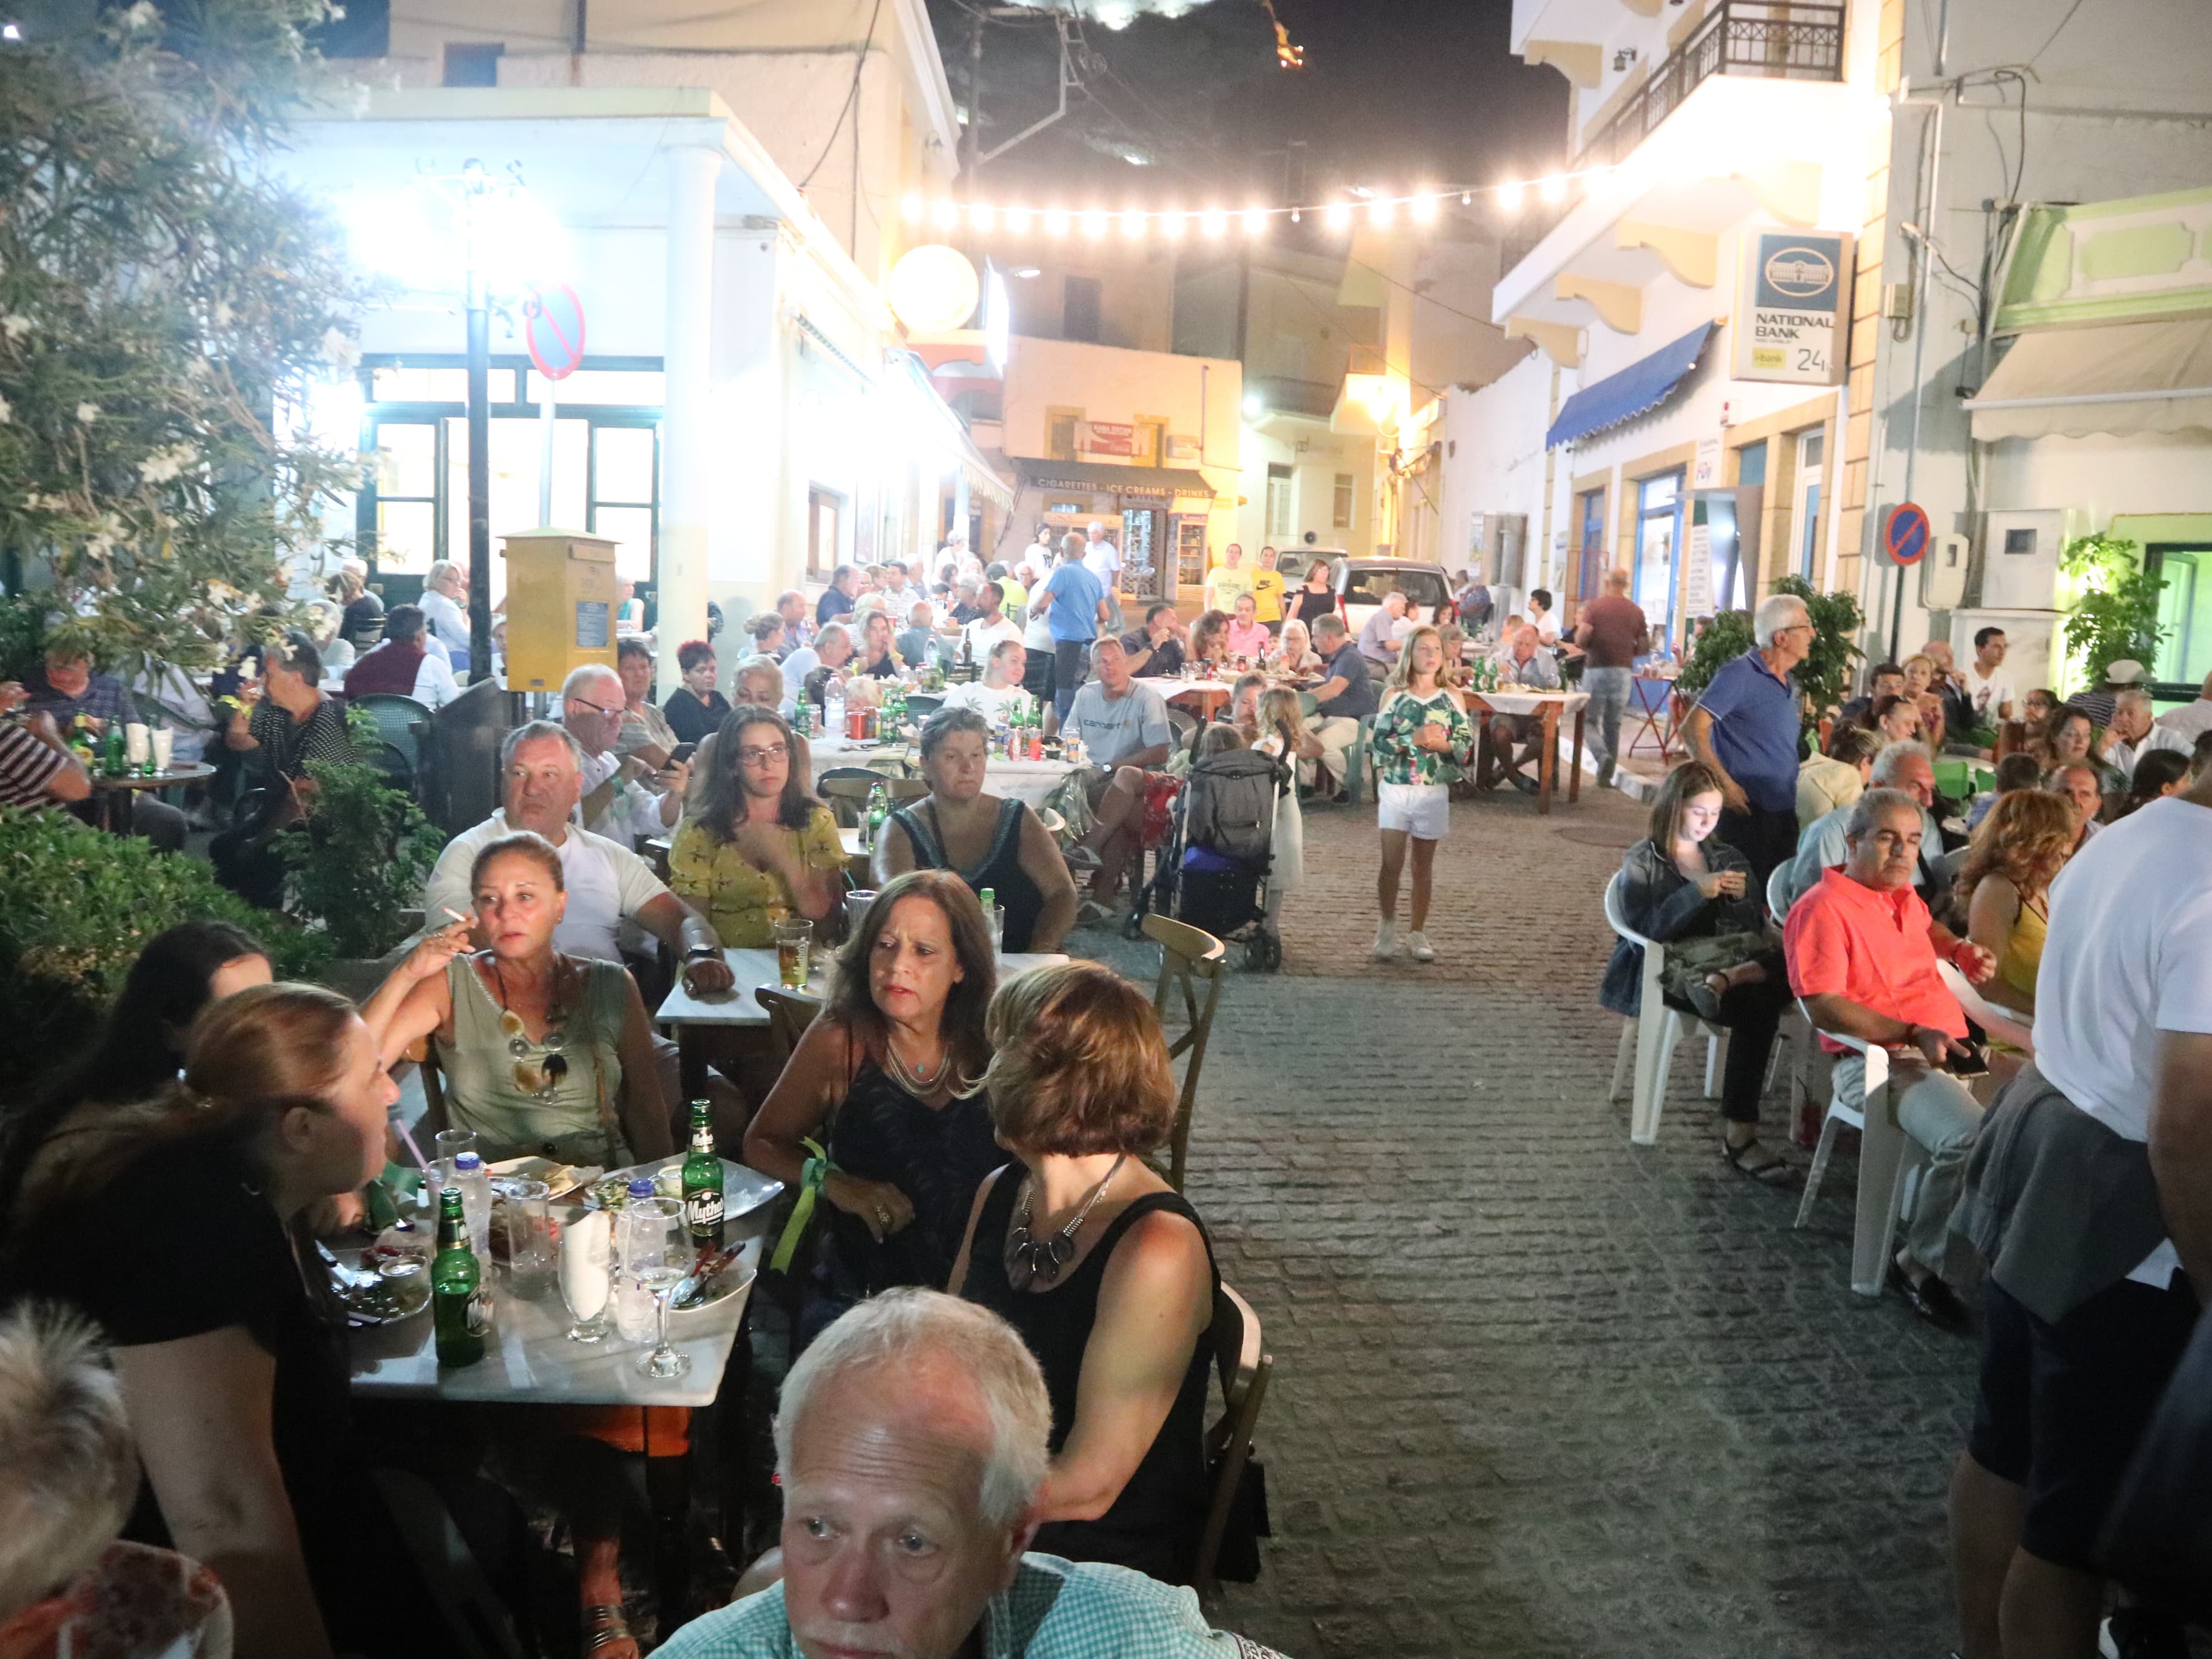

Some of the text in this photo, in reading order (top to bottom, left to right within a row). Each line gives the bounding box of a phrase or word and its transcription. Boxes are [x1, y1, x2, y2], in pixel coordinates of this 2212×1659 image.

[1756, 313, 1835, 328] NATIONAL
[1756, 326, 1800, 339] BANK
[1038, 478, 1097, 491] CIGARETTES
[1107, 484, 1123, 494] ICE
[1125, 486, 1165, 497] CREAMS
[1175, 488, 1209, 498] DRINKS
[688, 1197, 724, 1224] Mythos
